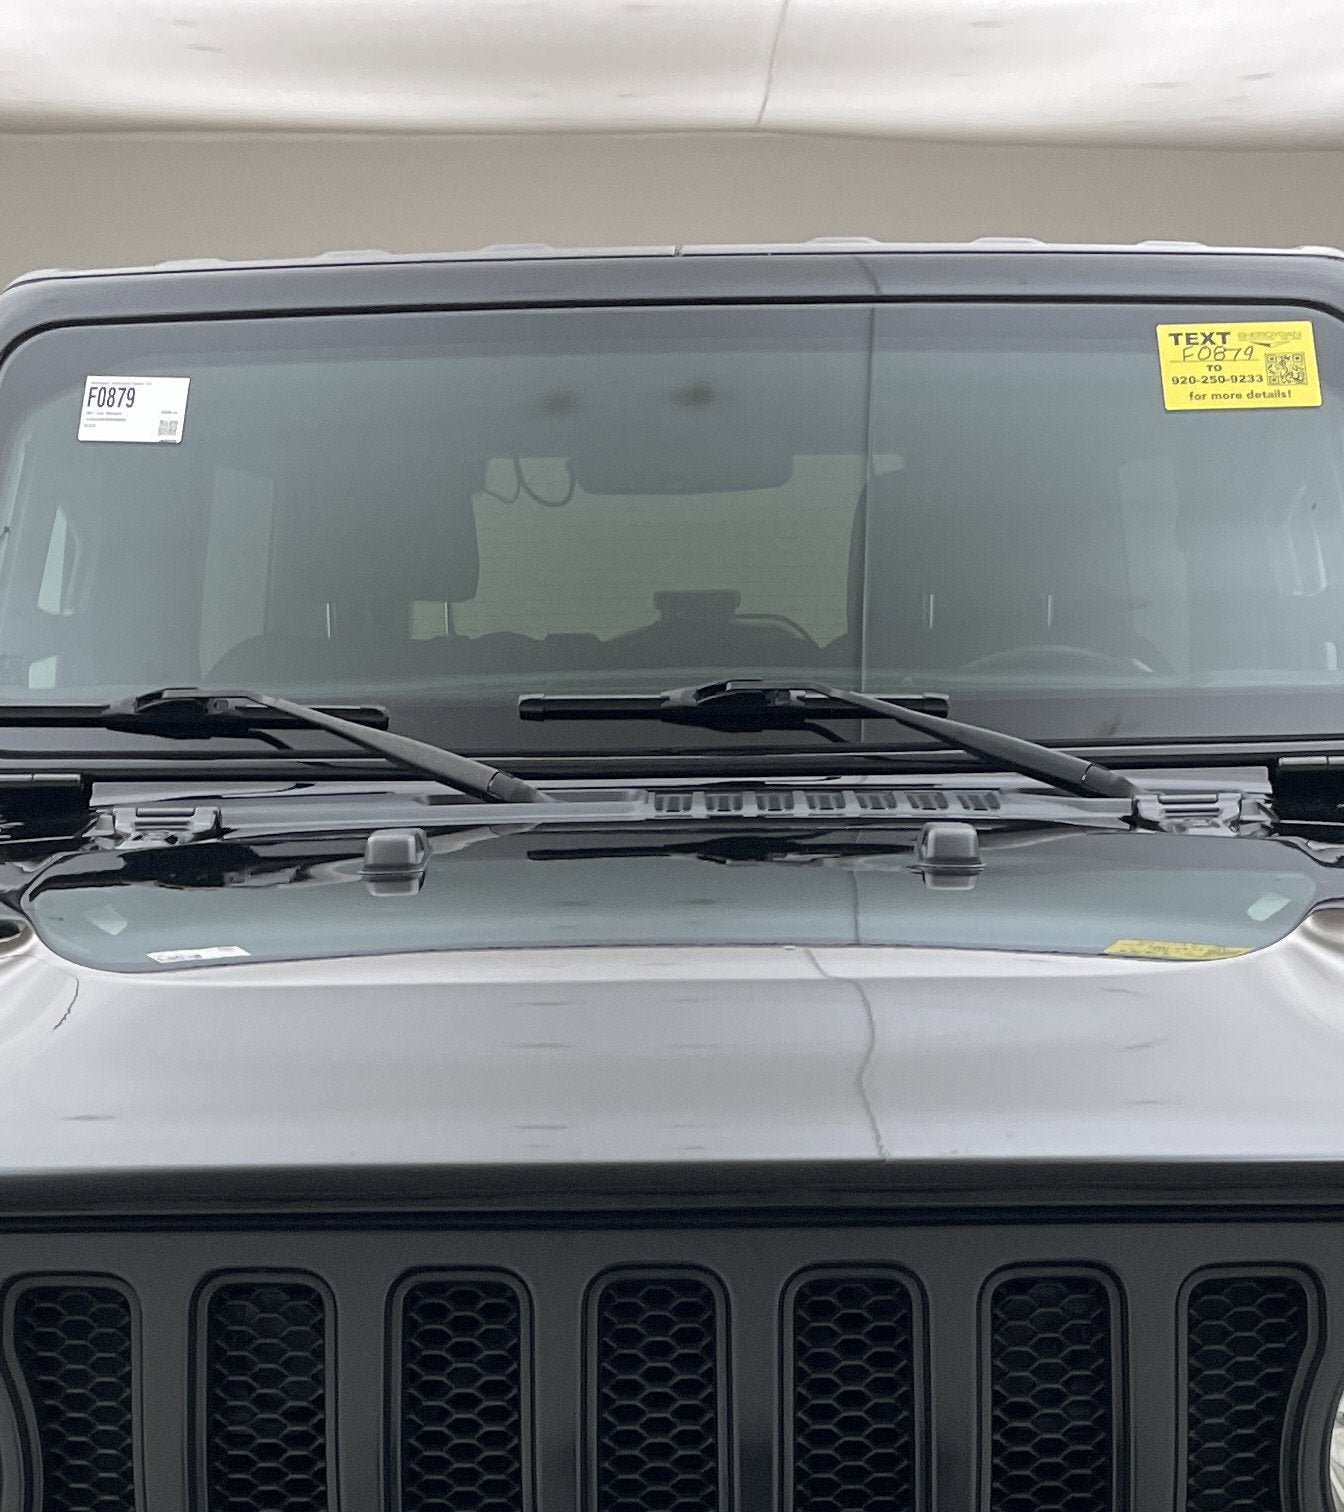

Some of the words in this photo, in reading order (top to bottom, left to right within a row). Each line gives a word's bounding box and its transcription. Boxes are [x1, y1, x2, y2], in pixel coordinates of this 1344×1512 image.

[1168, 331, 1231, 346] TEXT
[1182, 345, 1254, 362] F0879
[1206, 364, 1222, 372] TO
[87, 386, 136, 408] F0879
[1189, 391, 1207, 401] for
[1211, 392, 1242, 400] more
[1245, 389, 1292, 399] details!
